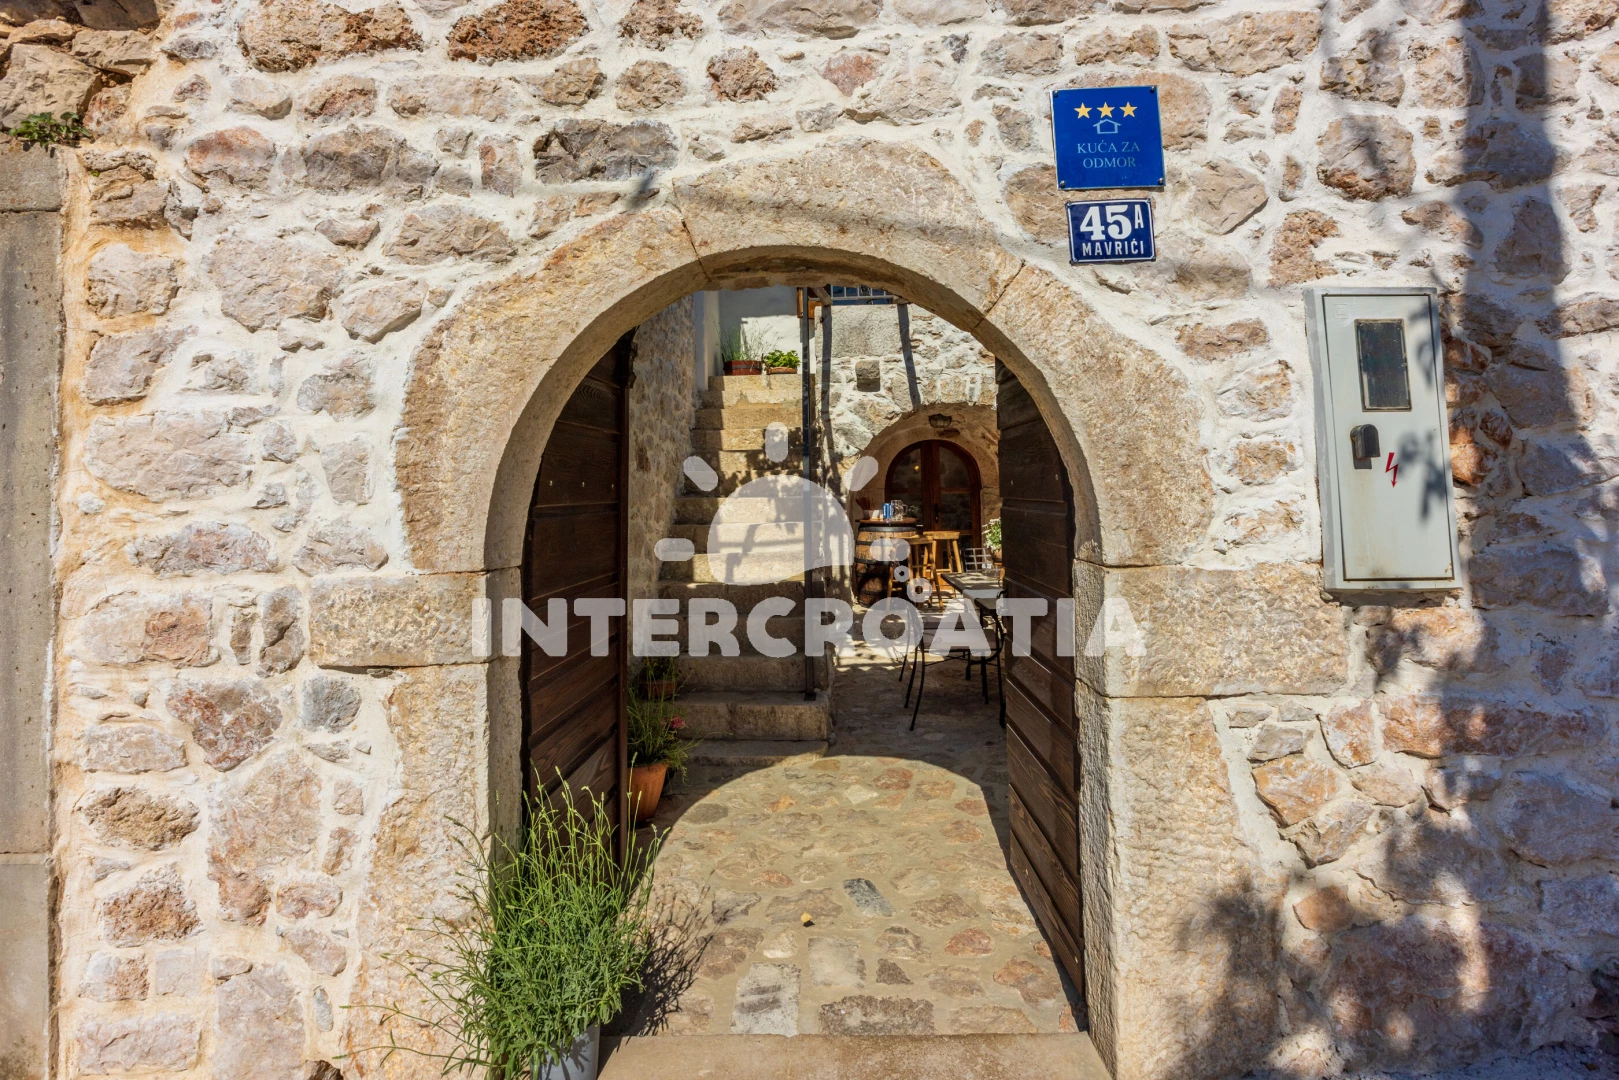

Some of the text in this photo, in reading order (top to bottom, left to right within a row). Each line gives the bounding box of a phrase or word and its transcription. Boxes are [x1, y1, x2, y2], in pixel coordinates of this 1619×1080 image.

[1077, 140, 1140, 154] KUĆA ZA
[1083, 157, 1136, 168] ODMOR
[1079, 204, 1144, 240] 45A
[1082, 238, 1144, 256] MAVRIĆI
